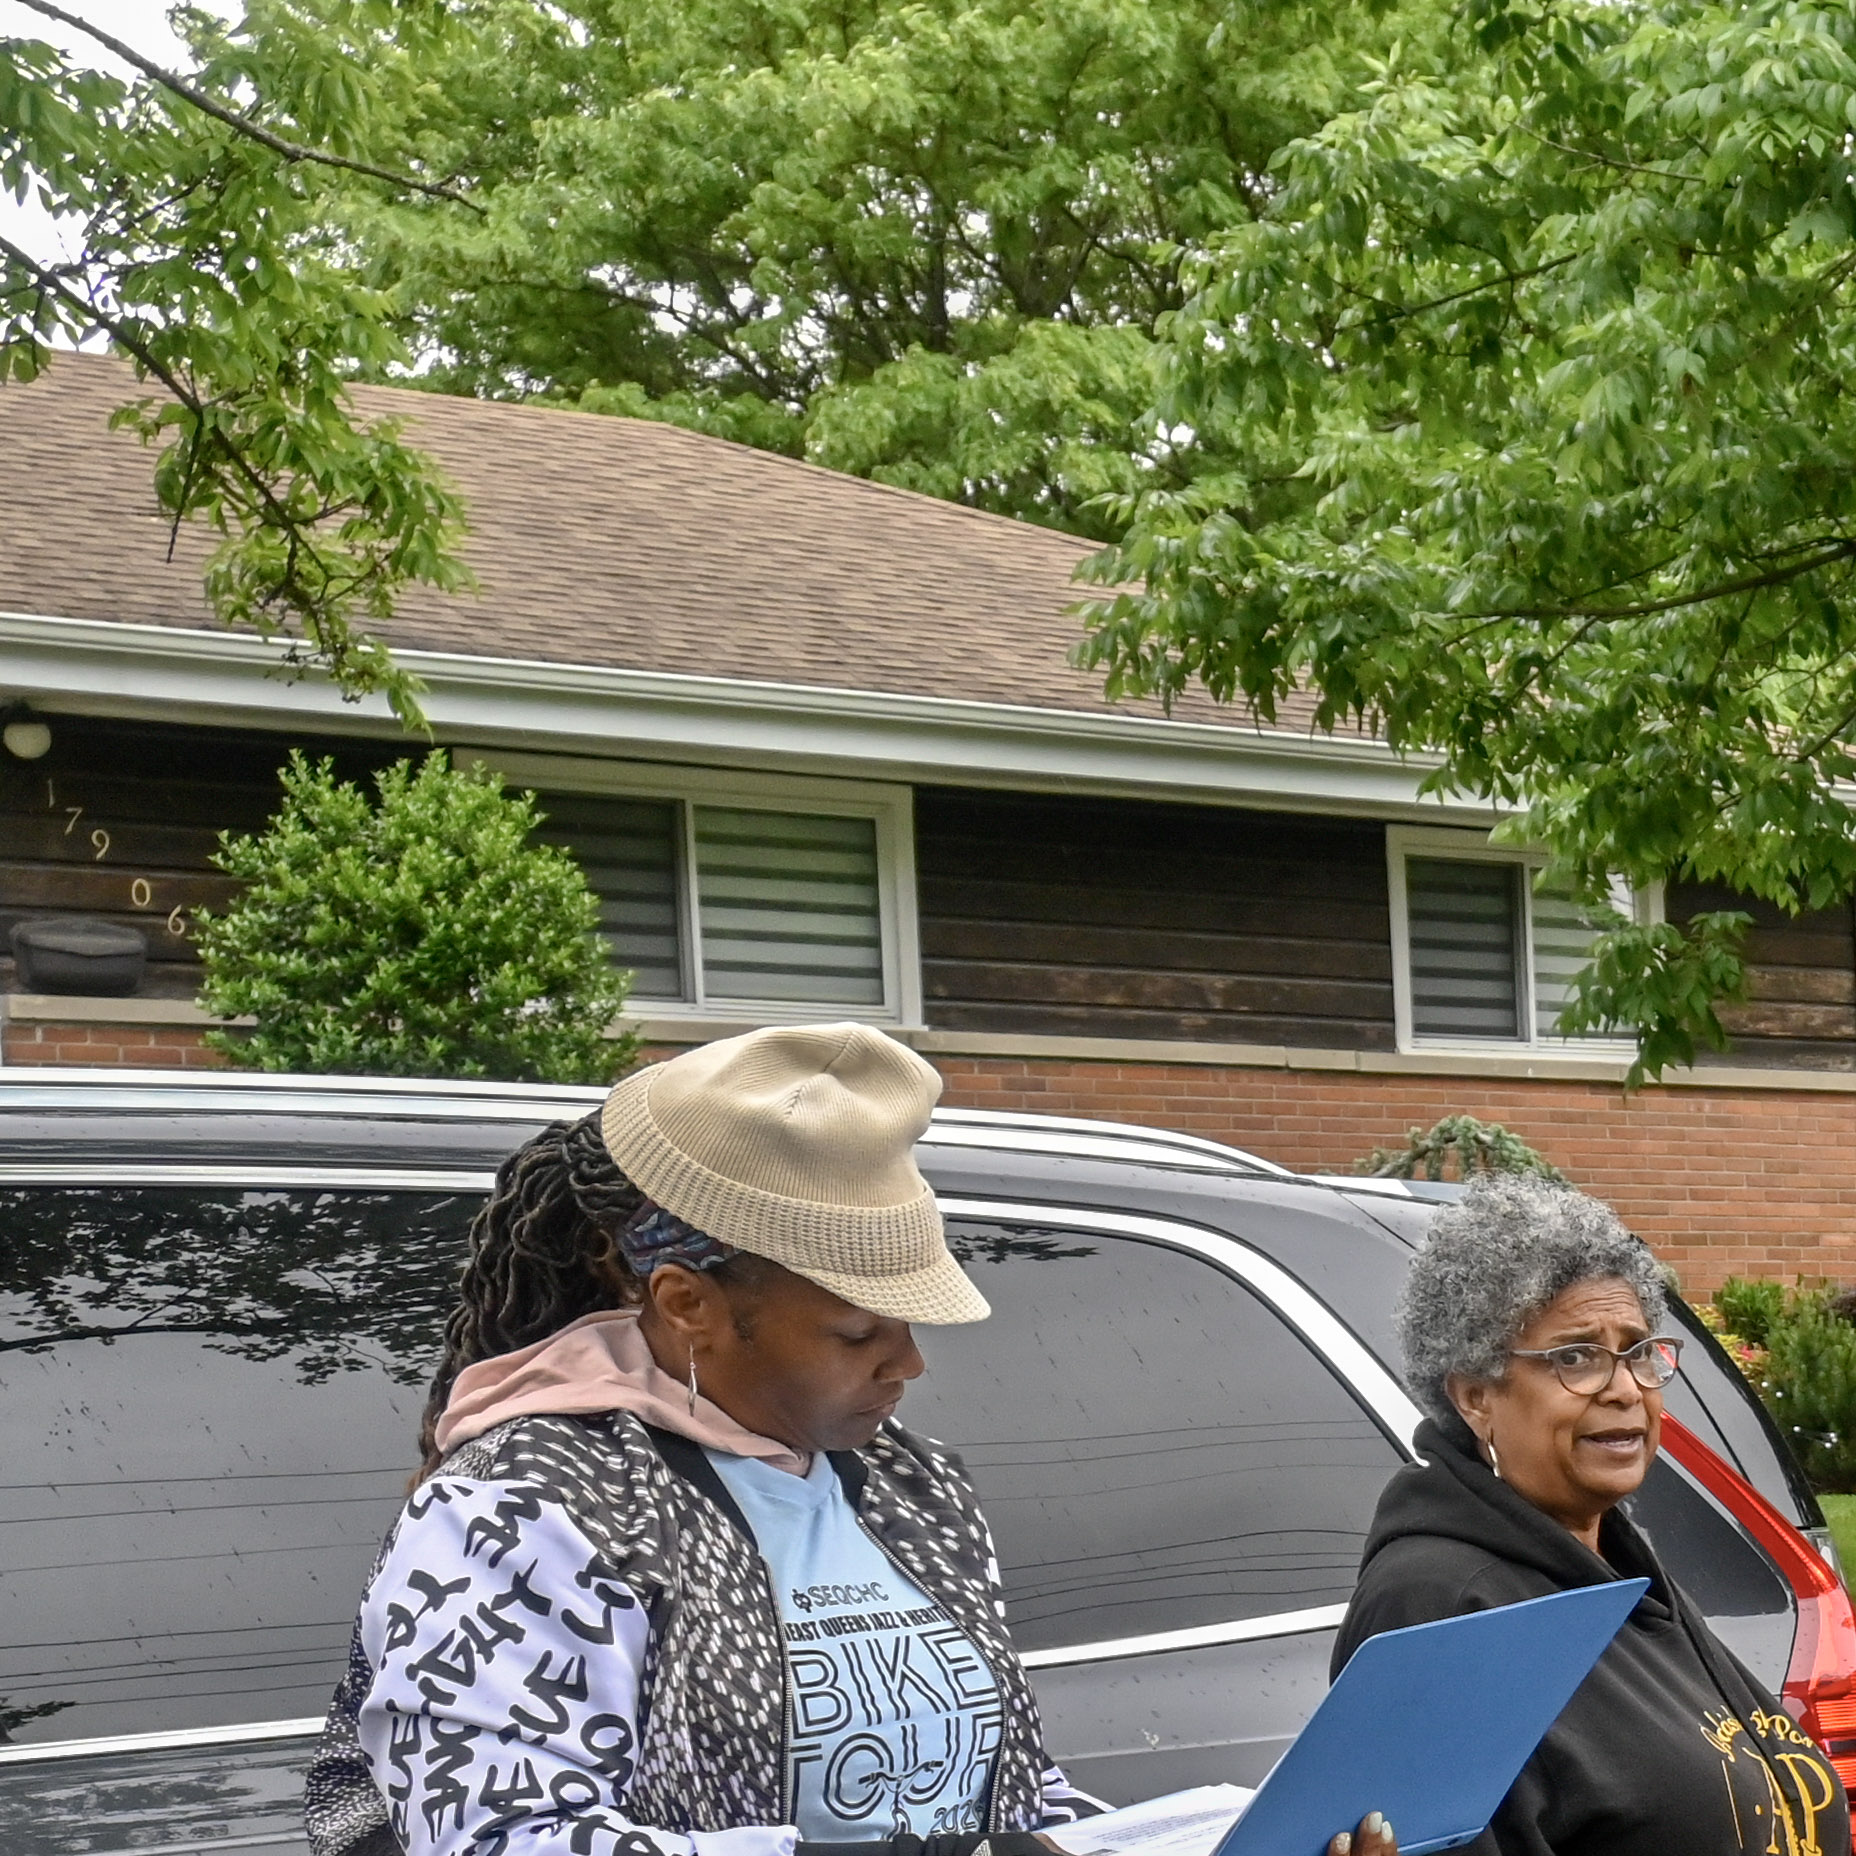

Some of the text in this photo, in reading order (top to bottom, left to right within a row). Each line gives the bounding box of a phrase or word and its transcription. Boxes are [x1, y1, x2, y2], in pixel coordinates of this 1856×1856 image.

[807, 1581, 890, 1608] SEQCHC
[821, 1612, 872, 1638] QUEENS
[873, 1609, 900, 1632] JAZZ
[901, 1607, 910, 1627] &
[787, 1626, 1000, 1739] BIKE
